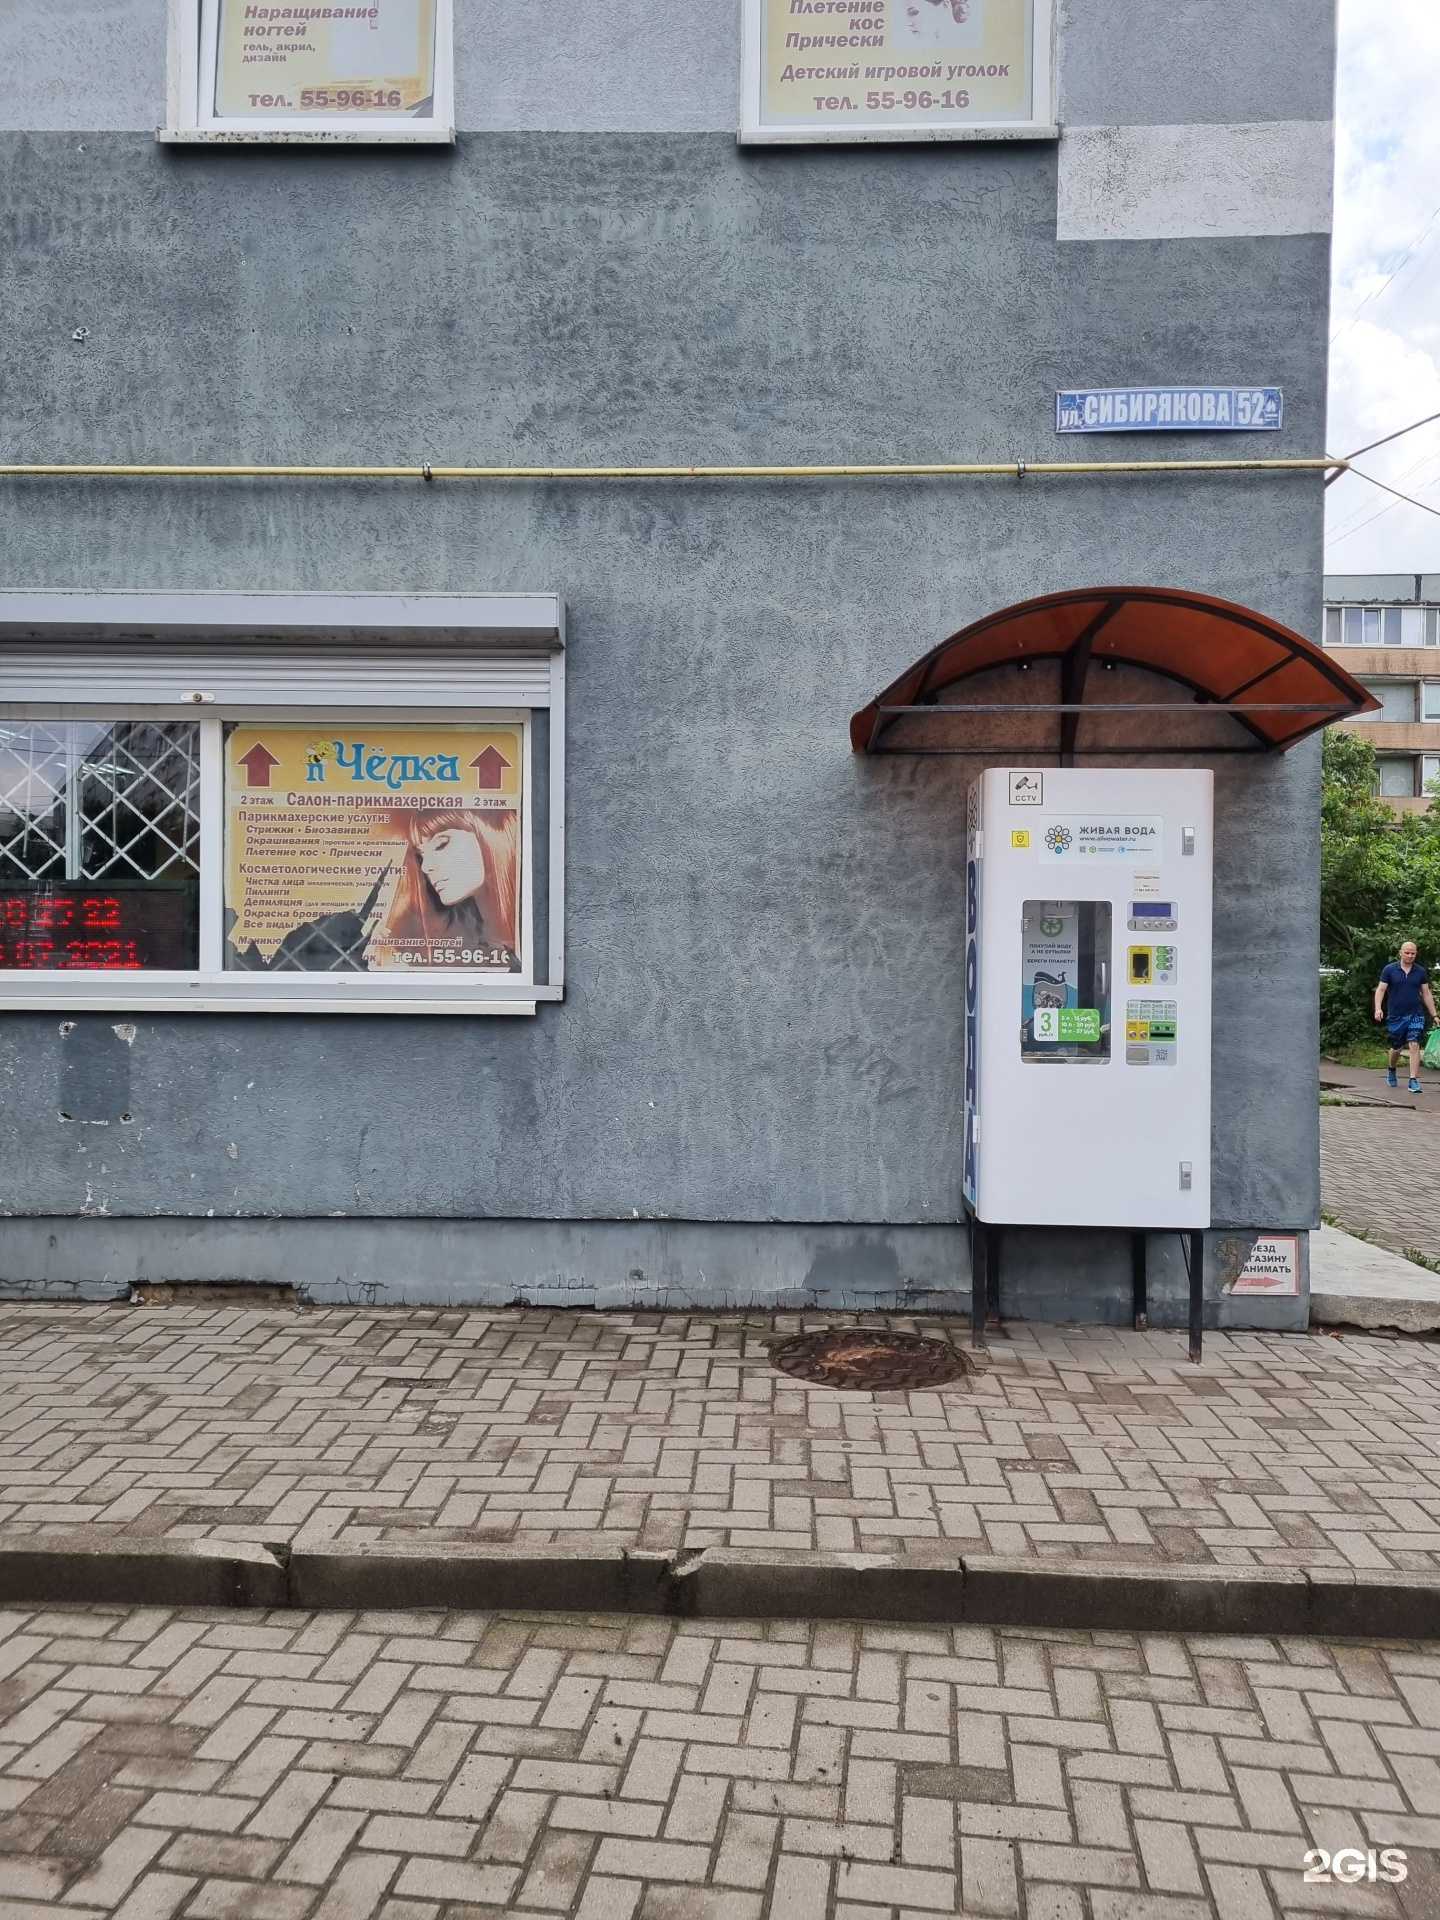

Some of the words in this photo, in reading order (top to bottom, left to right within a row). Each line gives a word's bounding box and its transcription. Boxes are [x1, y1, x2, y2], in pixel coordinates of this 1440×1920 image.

[789, 0, 885, 13] Плетение
[244, 6, 379, 21] Наращивание
[849, 17, 885, 30] кос
[243, 22, 307, 37] ногтей
[243, 42, 273, 52] гель,
[276, 42, 316, 53] акрил,
[785, 33, 884, 51] Прически
[242, 53, 287, 63] дизайн
[780, 62, 860, 82] Детский
[864, 61, 942, 81] игровой
[946, 65, 1009, 80] уголок
[248, 93, 293, 107] тел.
[300, 90, 401, 107] 55-96-16
[813, 96, 858, 110] тел.
[866, 90, 970, 110] 55-96-16
[1060, 409, 1084, 428] ул.
[1084, 392, 1232, 425] СИБИРЯКОВА
[1237, 391, 1265, 425] 52
[240, 796, 247, 804] 2
[250, 797, 274, 805] этаж
[287, 792, 463, 811] Салон-парикмахерская
[474, 797, 480, 806] 2
[483, 799, 507, 807] этаж
[239, 811, 344, 824] Парикмахерские
[347, 813, 390, 824] услуги:
[246, 825, 294, 835] Стрижки
[304, 826, 370, 835] Биозавивки
[1079, 826, 1120, 835] ЖИВАЯ
[1125, 826, 1156, 836] ВОДА
[246, 836, 320, 847] Окрашивания
[245, 848, 297, 857] Плетение
[300, 849, 319, 857] кос
[329, 848, 383, 858] Прически
[239, 863, 362, 875] Косметологические
[246, 876, 280, 886] Чистка
[281, 879, 305, 887] лица
[245, 888, 290, 896] Пиллинги
[243, 898, 303, 908] Депиляция
[243, 909, 290, 919] Окраска
[243, 920, 263, 929] Все
[266, 922, 294, 930] виды
[392, 952, 428, 963] тел.
[1041, 1012, 1052, 1032] 3
[1253, 1245, 1276, 1253] ЕЗД
[1249, 1255, 1287, 1263] ГАЗИНУ
[1242, 1265, 1291, 1273] АНИМАТЬ
